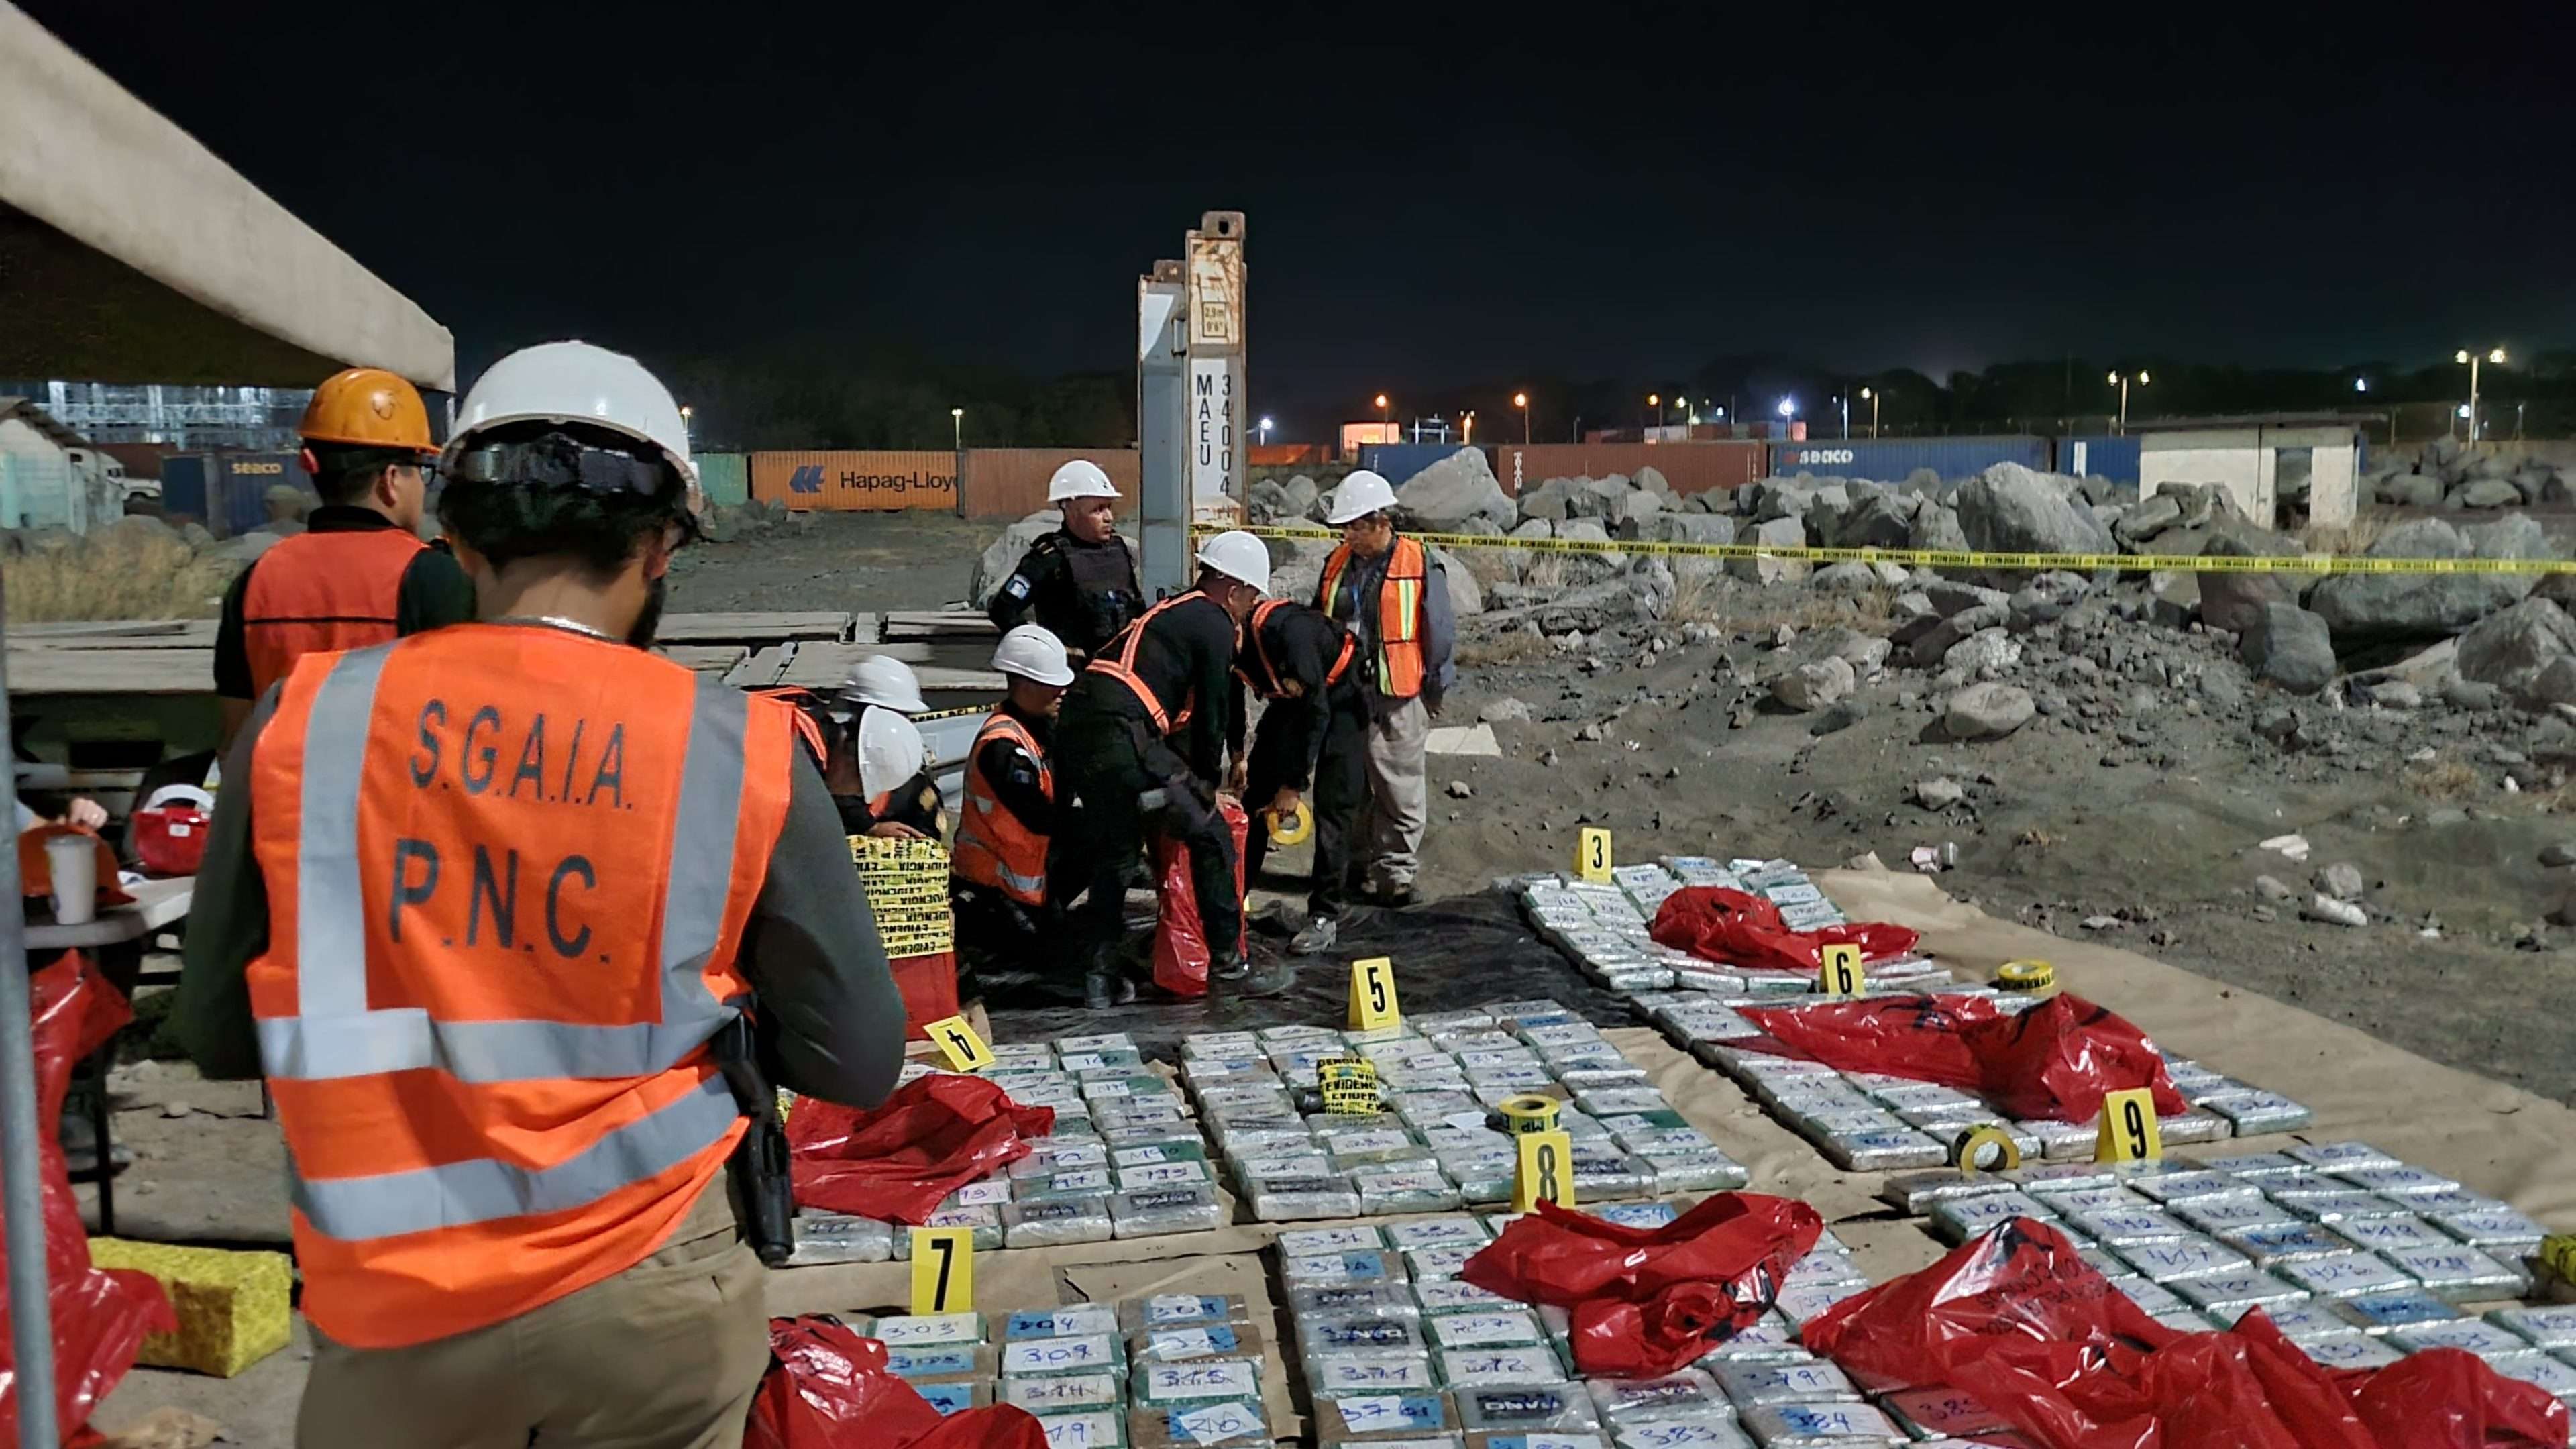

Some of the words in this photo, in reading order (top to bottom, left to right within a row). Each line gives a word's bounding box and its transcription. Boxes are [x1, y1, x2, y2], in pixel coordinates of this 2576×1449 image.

[1196, 374, 1212, 466] MAEU
[409, 698, 633, 810] S.G.A.I.A.
[1592, 835, 1603, 869] 3
[389, 837, 610, 963] P.N.C.
[1367, 967, 1385, 1012] 5
[1836, 951, 1852, 994] 6
[946, 1028, 977, 1062] 4
[1521, 1121, 1545, 1132] MP
[2124, 1100, 2147, 1159] 9
[1538, 1144, 1559, 1206] 8
[931, 1238, 953, 1311] 7
[1022, 1344, 1095, 1364] 309
